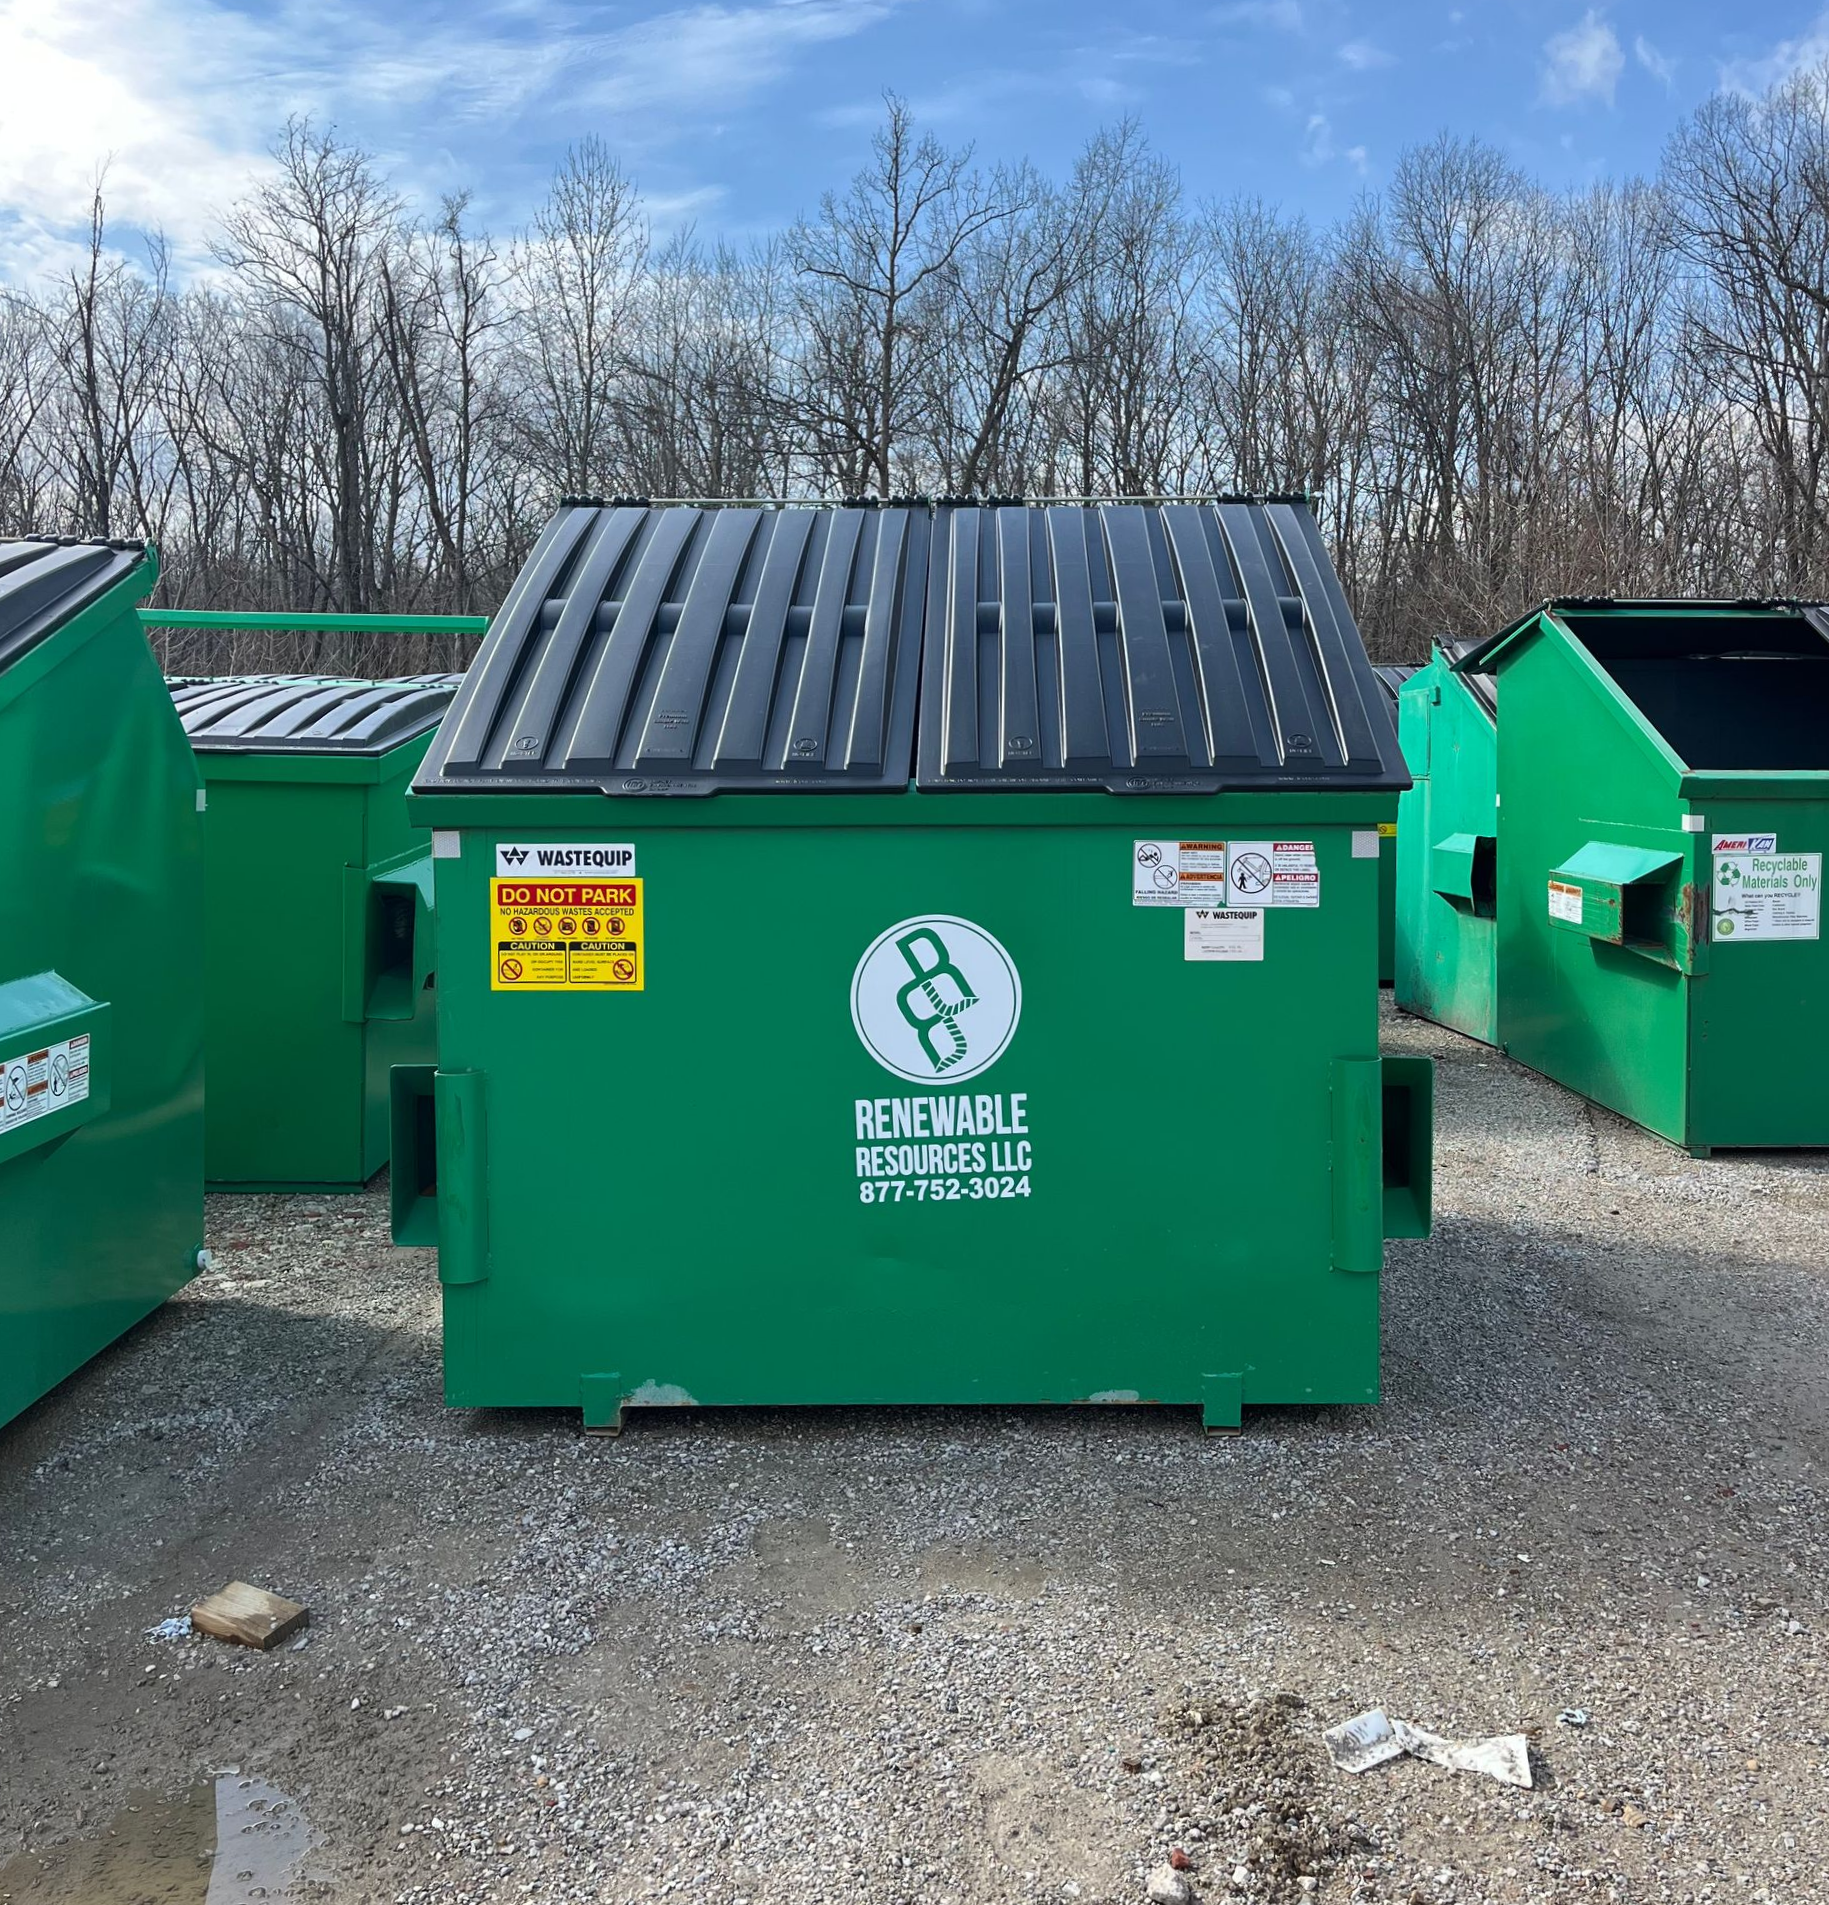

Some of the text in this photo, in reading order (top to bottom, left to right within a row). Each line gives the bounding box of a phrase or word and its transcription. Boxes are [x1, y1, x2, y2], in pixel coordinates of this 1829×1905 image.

[537, 850, 632, 867] WASTEQUIP
[1752, 858, 1808, 875] Recyclable
[1742, 874, 1817, 890] Materials Only
[502, 888, 632, 903] DO NOT PARK
[500, 907, 634, 916] NO HAZARDOUS WASTES ACCEPTED
[1213, 911, 1257, 920] WASTEQUIP
[510, 942, 555, 950] CAUTION
[581, 942, 625, 950] CAUTION
[854, 1093, 1028, 1139] RENEWABLE
[855, 1140, 1032, 1177] RESOURCES LLC
[859, 1175, 1032, 1204] 877-752-3024
